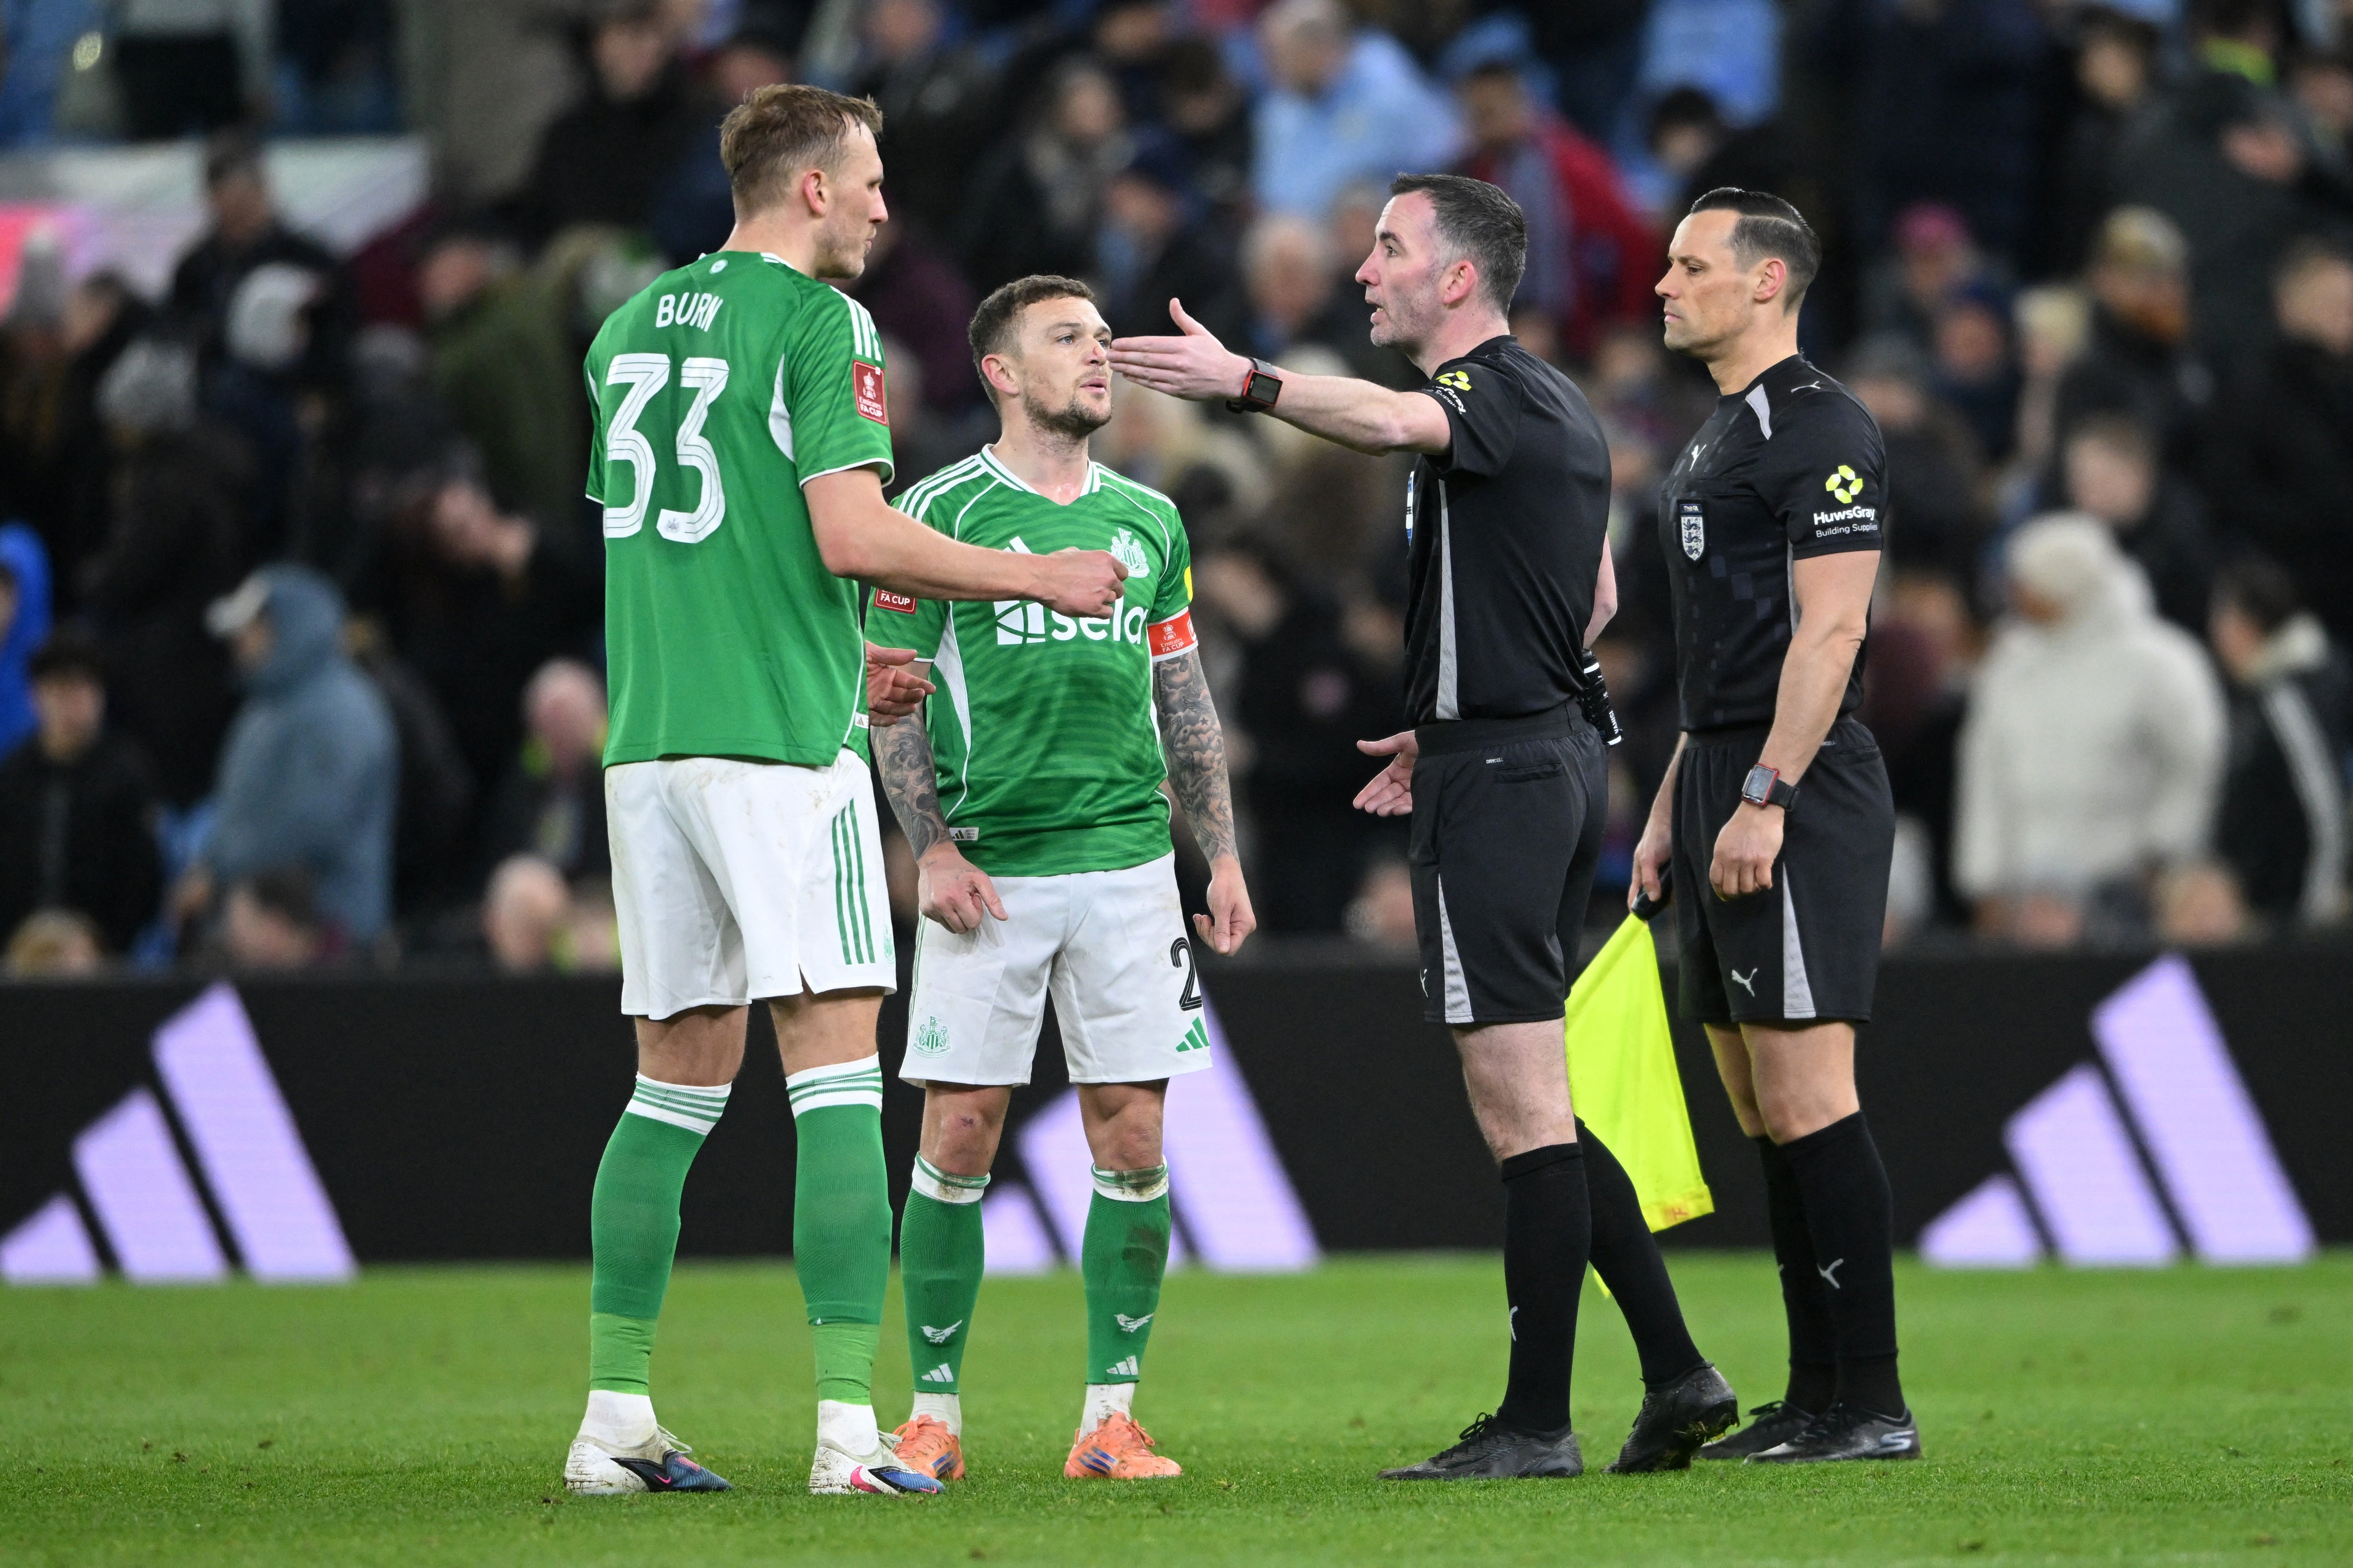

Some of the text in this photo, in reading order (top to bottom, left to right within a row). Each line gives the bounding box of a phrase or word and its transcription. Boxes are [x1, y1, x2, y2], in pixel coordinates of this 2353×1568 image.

[655, 292, 724, 332] BURN
[860, 404, 883, 418] FA CUP
[603, 353, 729, 543] 33
[1813, 506, 1876, 525] HuwsGray
[1816, 523, 1878, 538] Building Supplies
[881, 593, 910, 606] FA CUP
[1051, 594, 1149, 645] sela
[1160, 638, 1183, 648] Emirates
[1171, 642, 1184, 650] CUP
[1170, 937, 1202, 1012] 2
